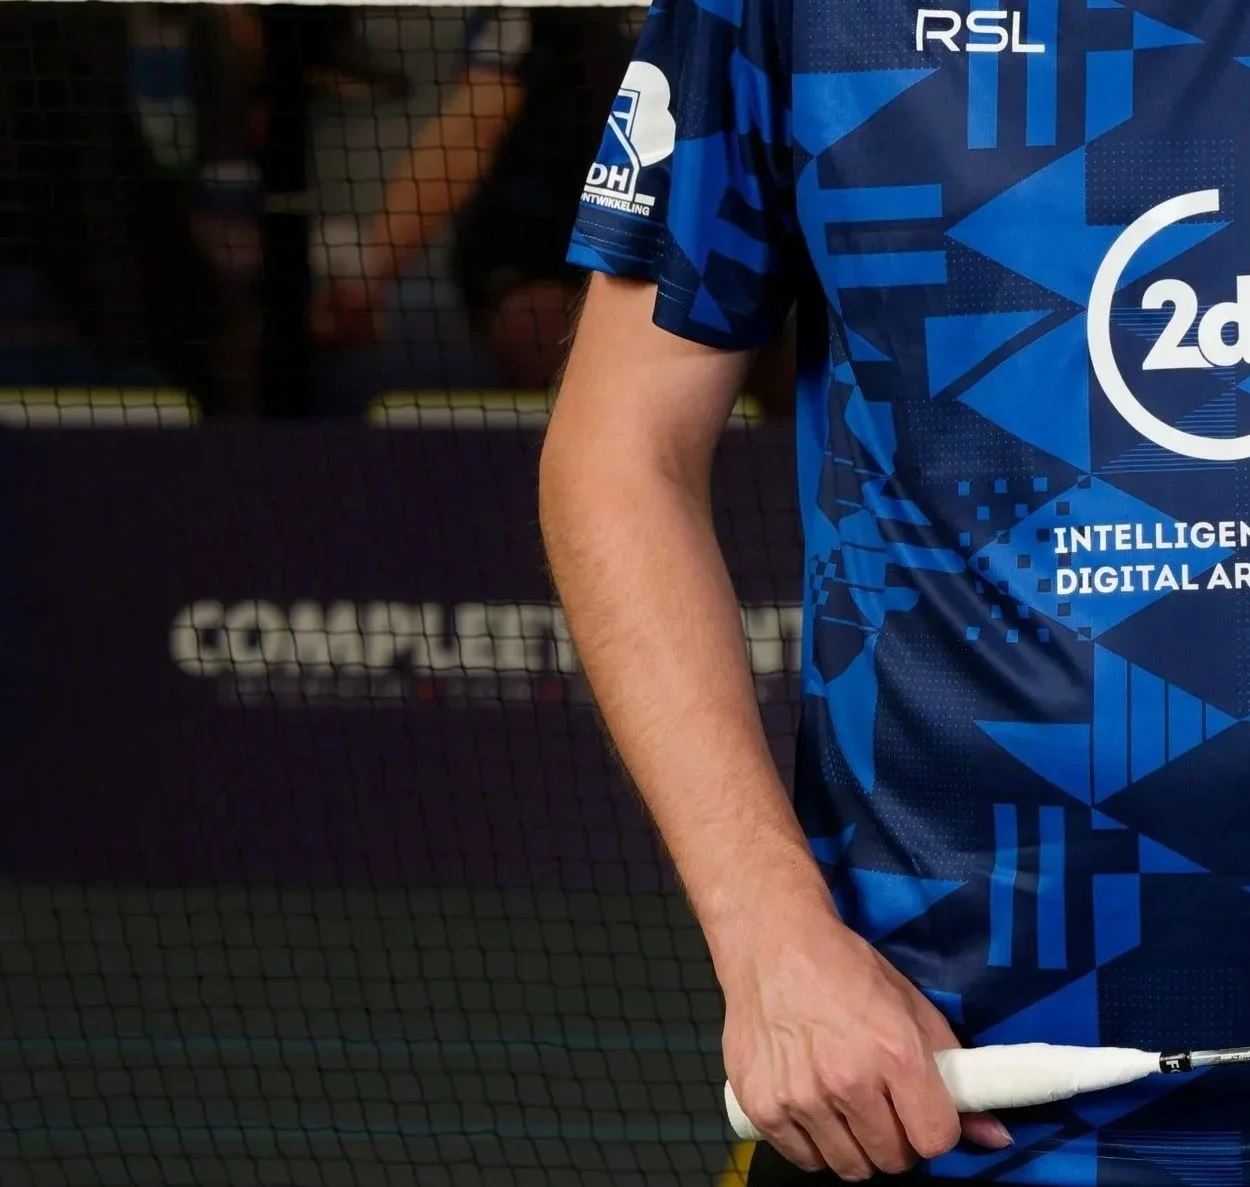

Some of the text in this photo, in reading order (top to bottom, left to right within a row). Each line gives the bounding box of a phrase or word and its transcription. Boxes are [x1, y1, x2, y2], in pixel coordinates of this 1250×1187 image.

[916, 9, 1045, 53] RSL
[580, 192, 650, 217] NTWIKKELING
[1056, 564, 1199, 595] DIGITAL
